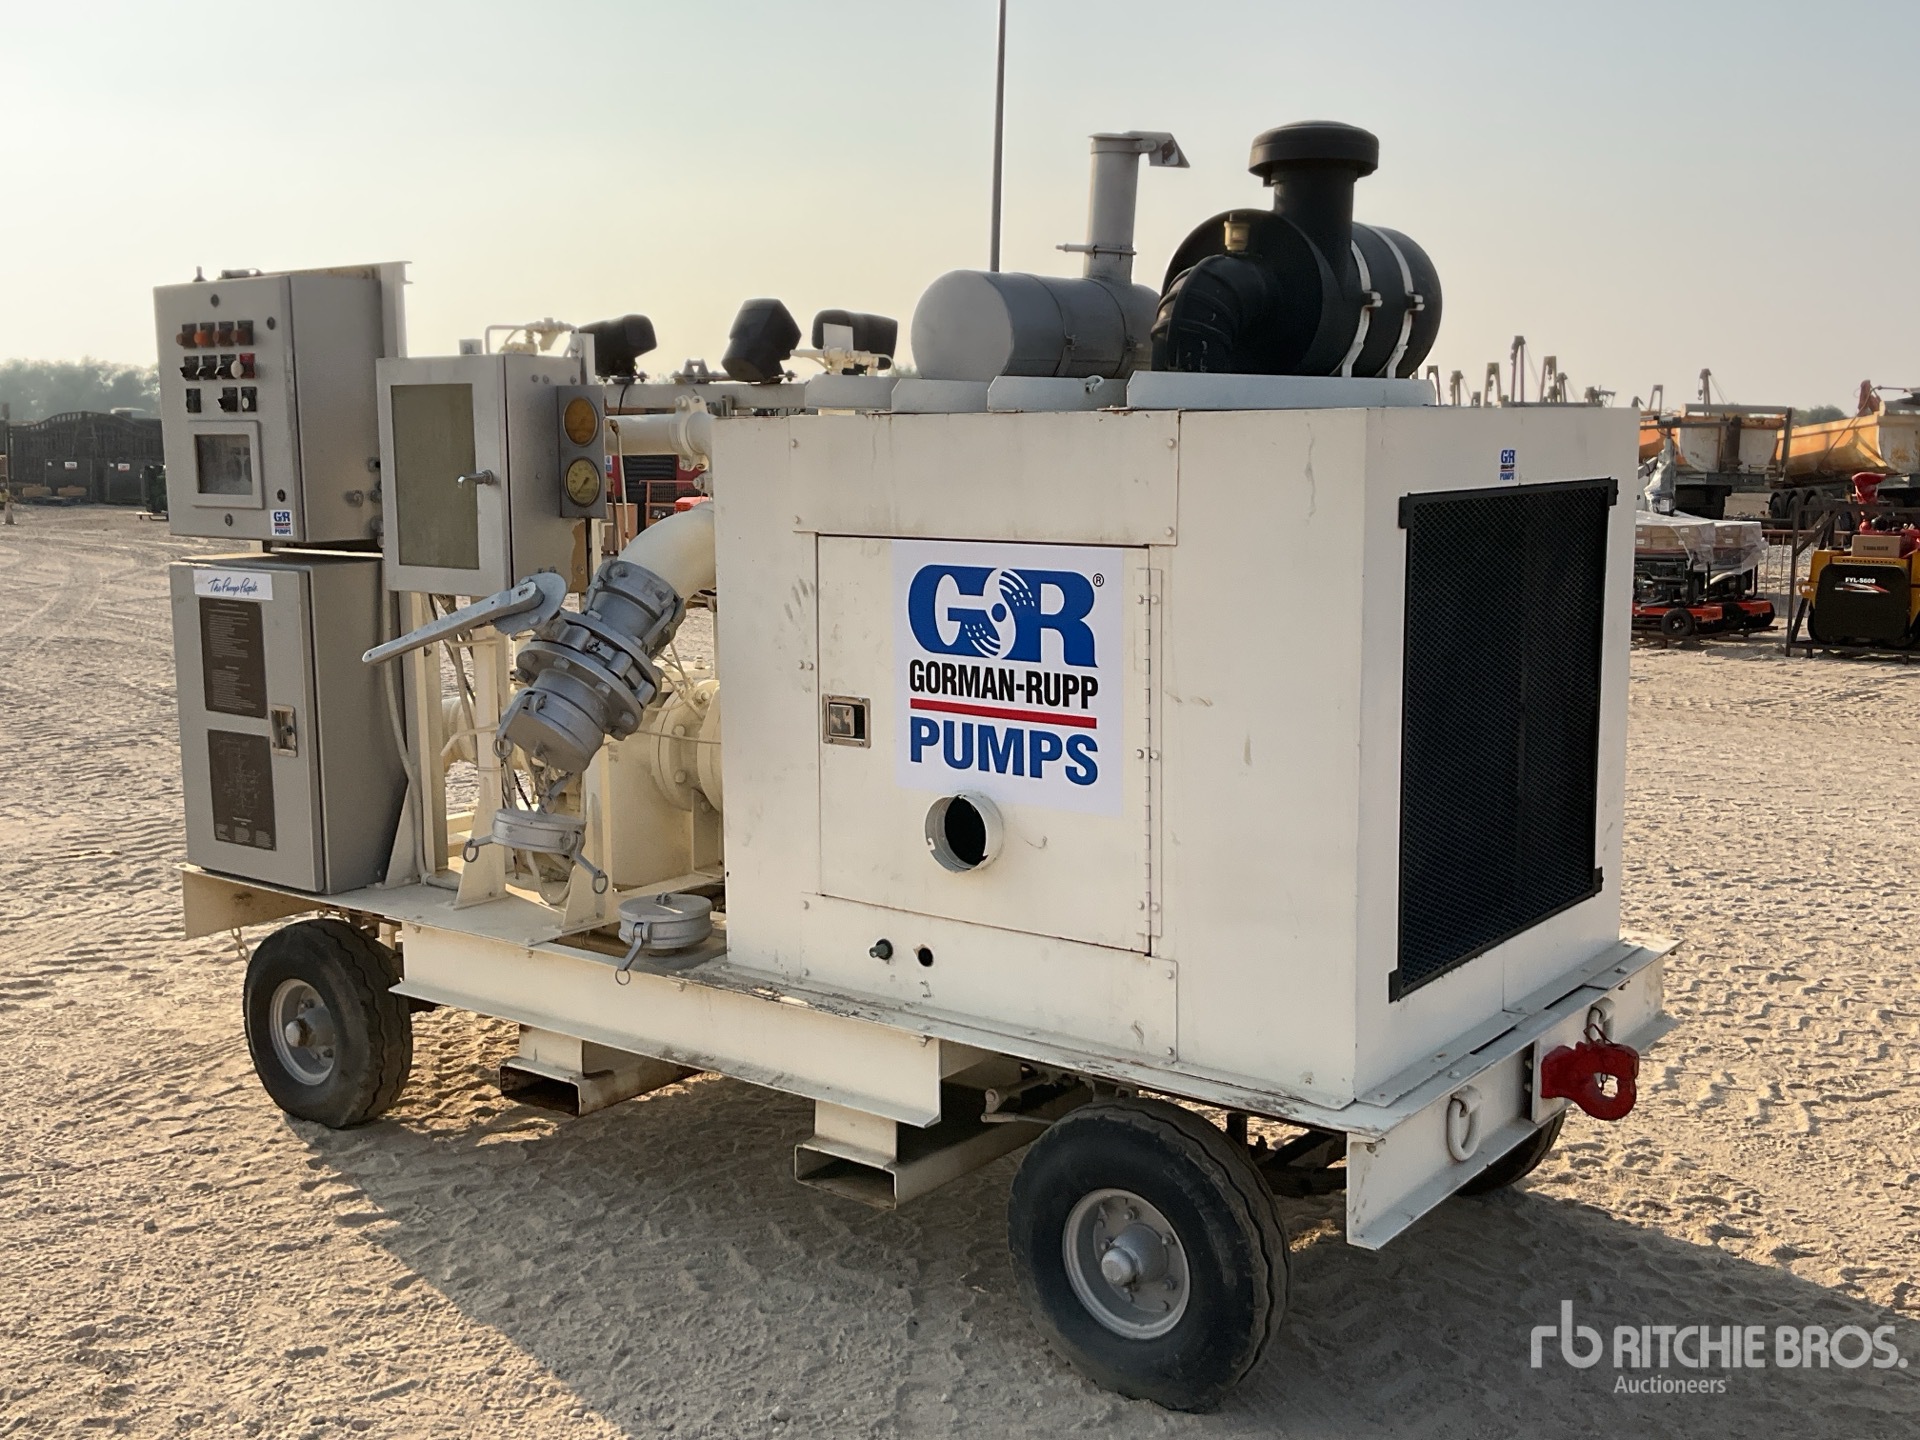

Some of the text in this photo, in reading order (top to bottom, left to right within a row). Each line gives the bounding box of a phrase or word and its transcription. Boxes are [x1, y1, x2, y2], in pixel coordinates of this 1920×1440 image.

[274, 511, 290, 522] GR
[910, 659, 1098, 709] GORMAN-RUPP
[910, 716, 1098, 786] PUMPS
